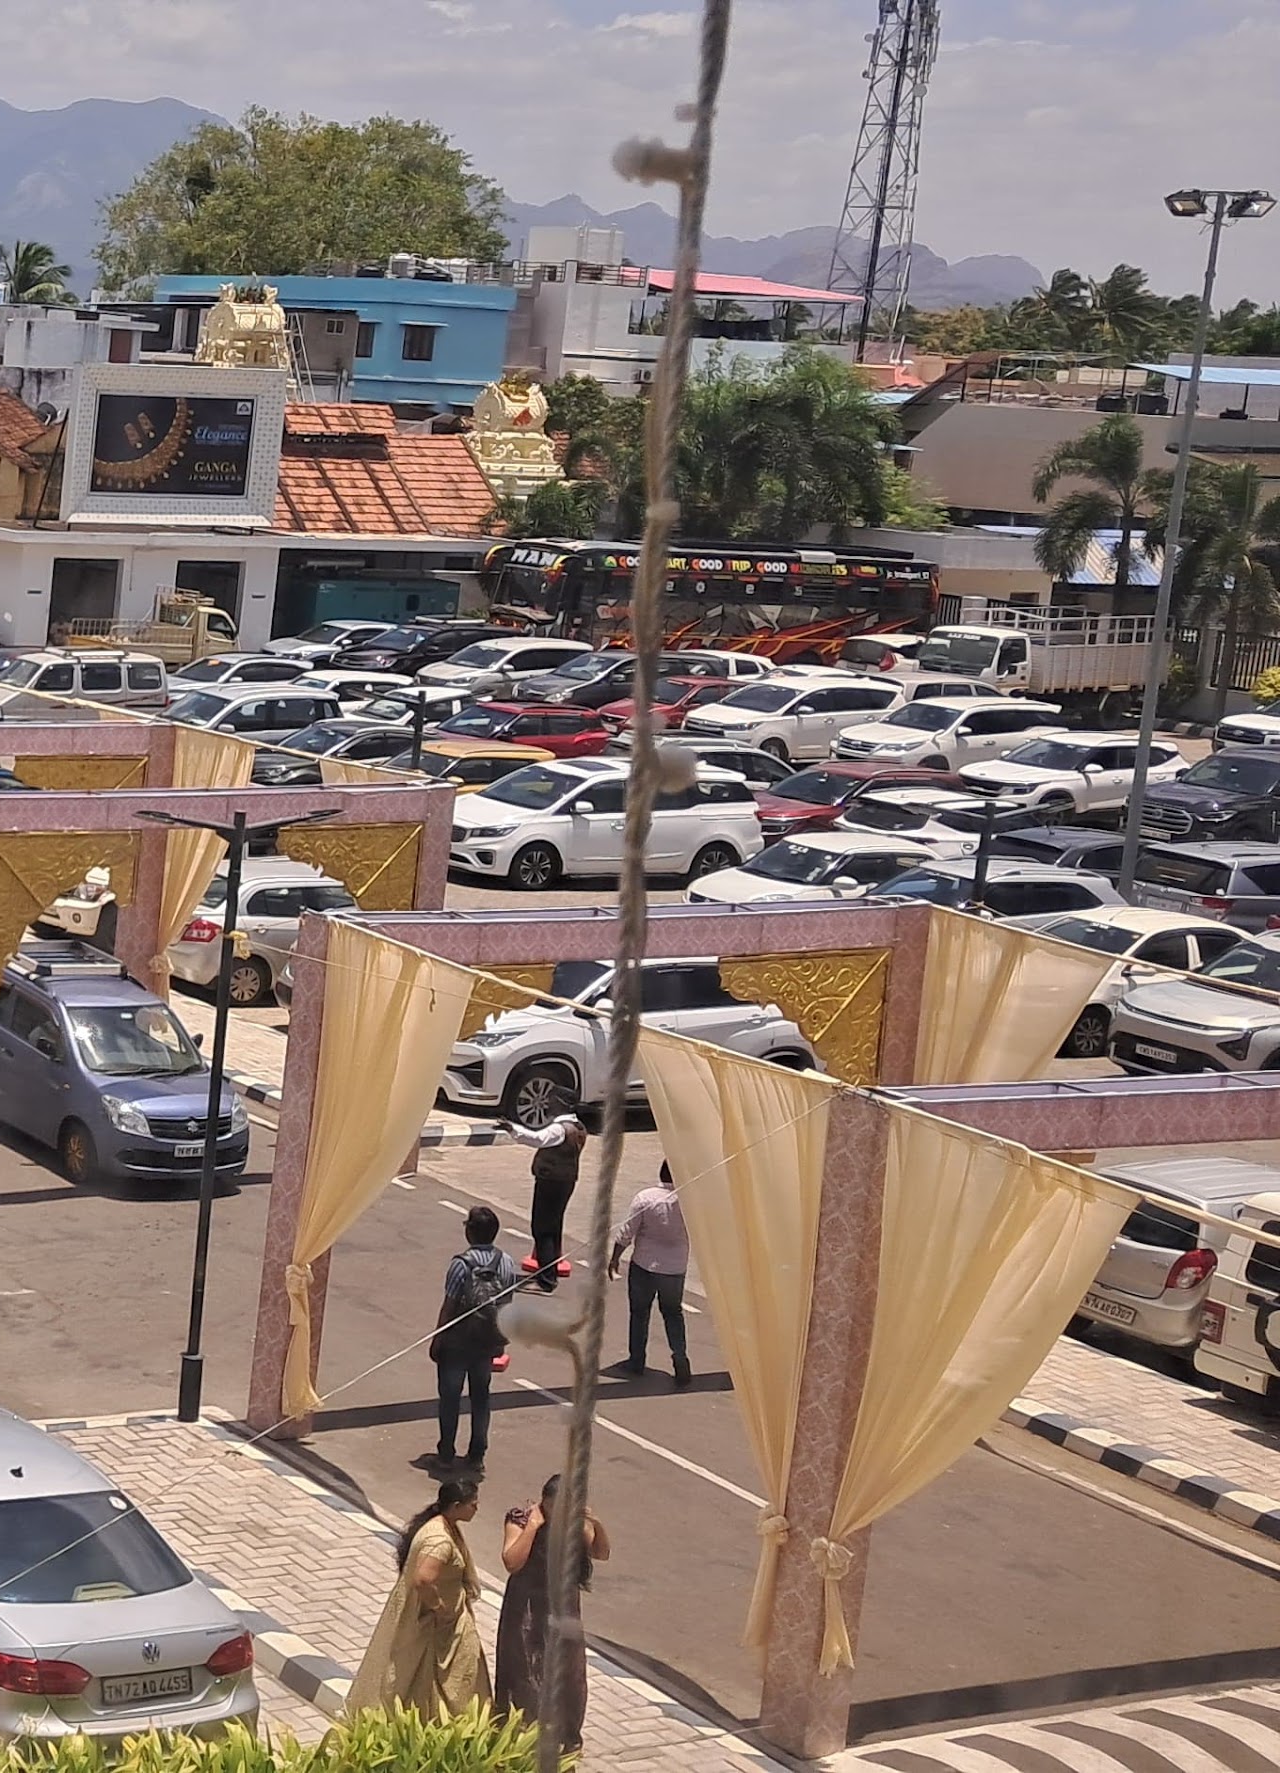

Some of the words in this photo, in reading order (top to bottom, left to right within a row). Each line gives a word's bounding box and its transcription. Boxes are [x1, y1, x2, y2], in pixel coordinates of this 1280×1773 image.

[194, 462, 238, 473] GANGA
[507, 549, 557, 567] MAN
[692, 557, 724, 573] GOOD
